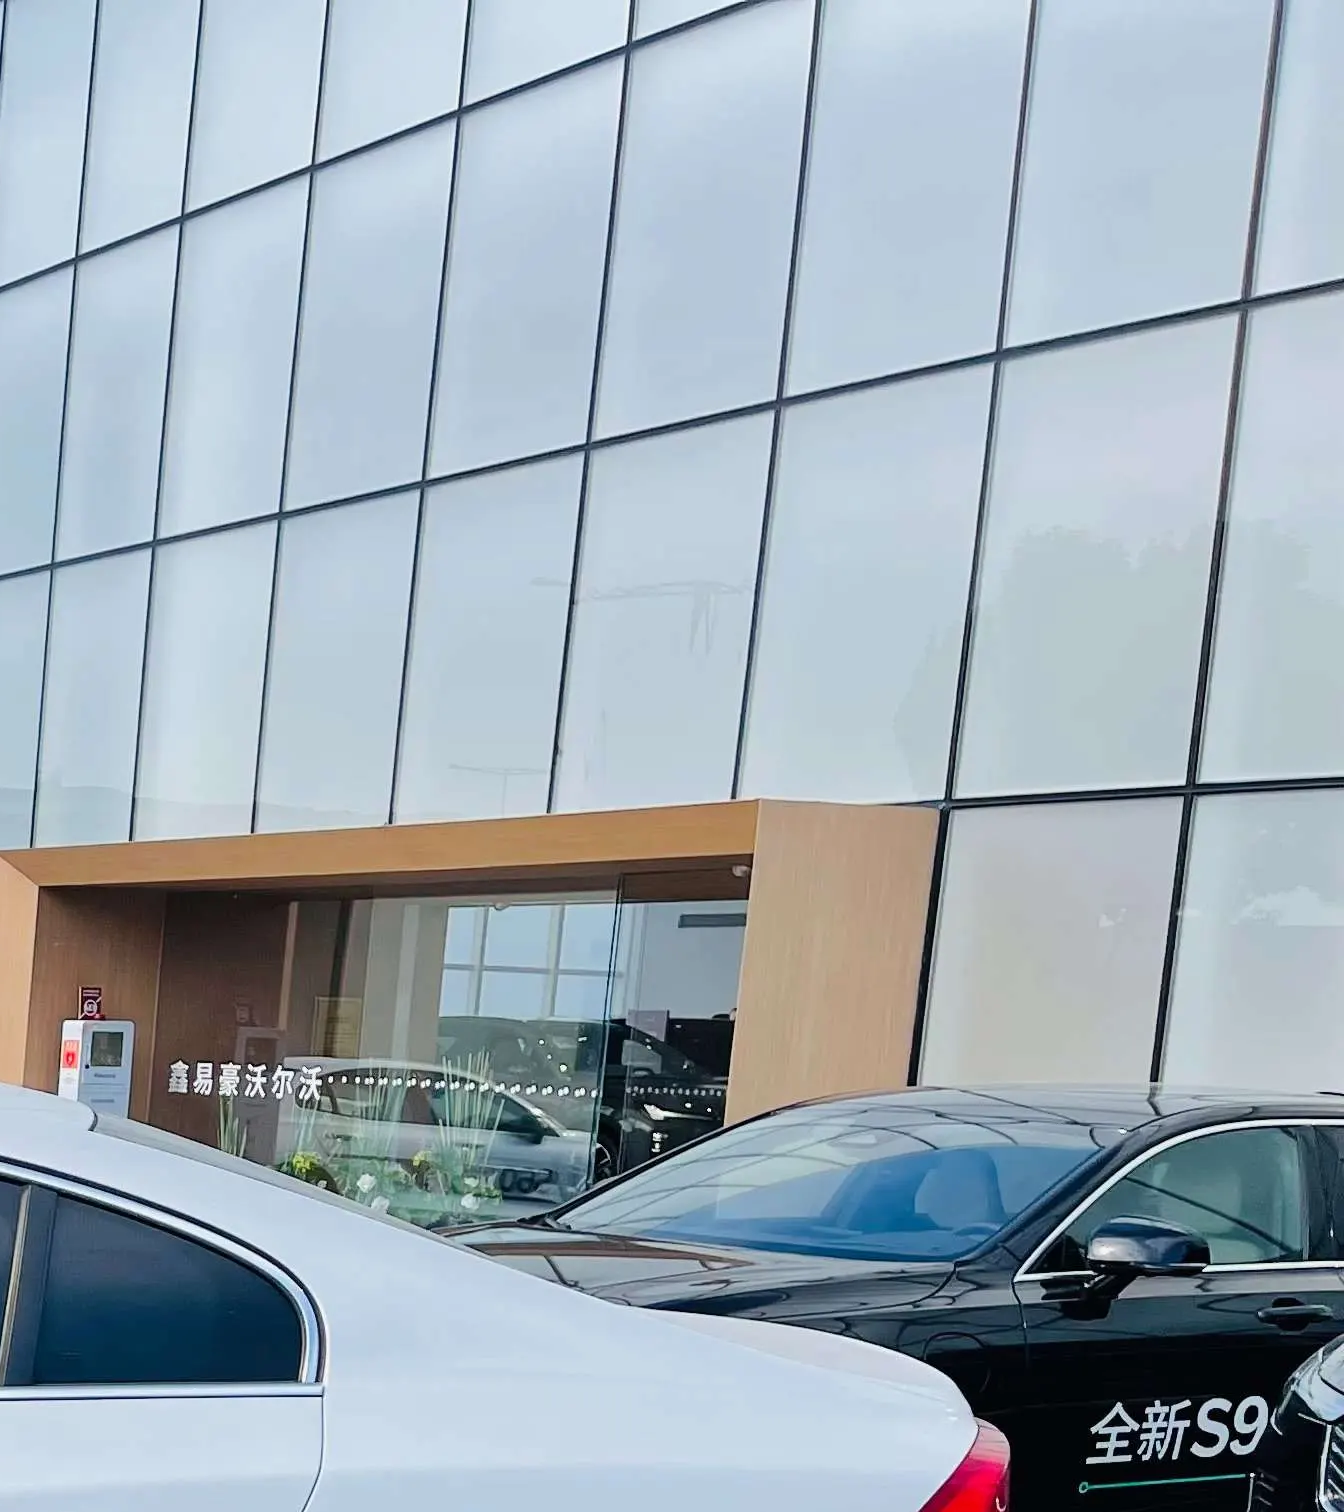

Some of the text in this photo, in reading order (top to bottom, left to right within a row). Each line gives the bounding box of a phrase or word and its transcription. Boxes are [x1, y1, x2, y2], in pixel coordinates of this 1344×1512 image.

[168, 1060, 322, 1101] 鑫易豪沃尔沃
[1086, 1395, 1283, 1464] 全新S9
